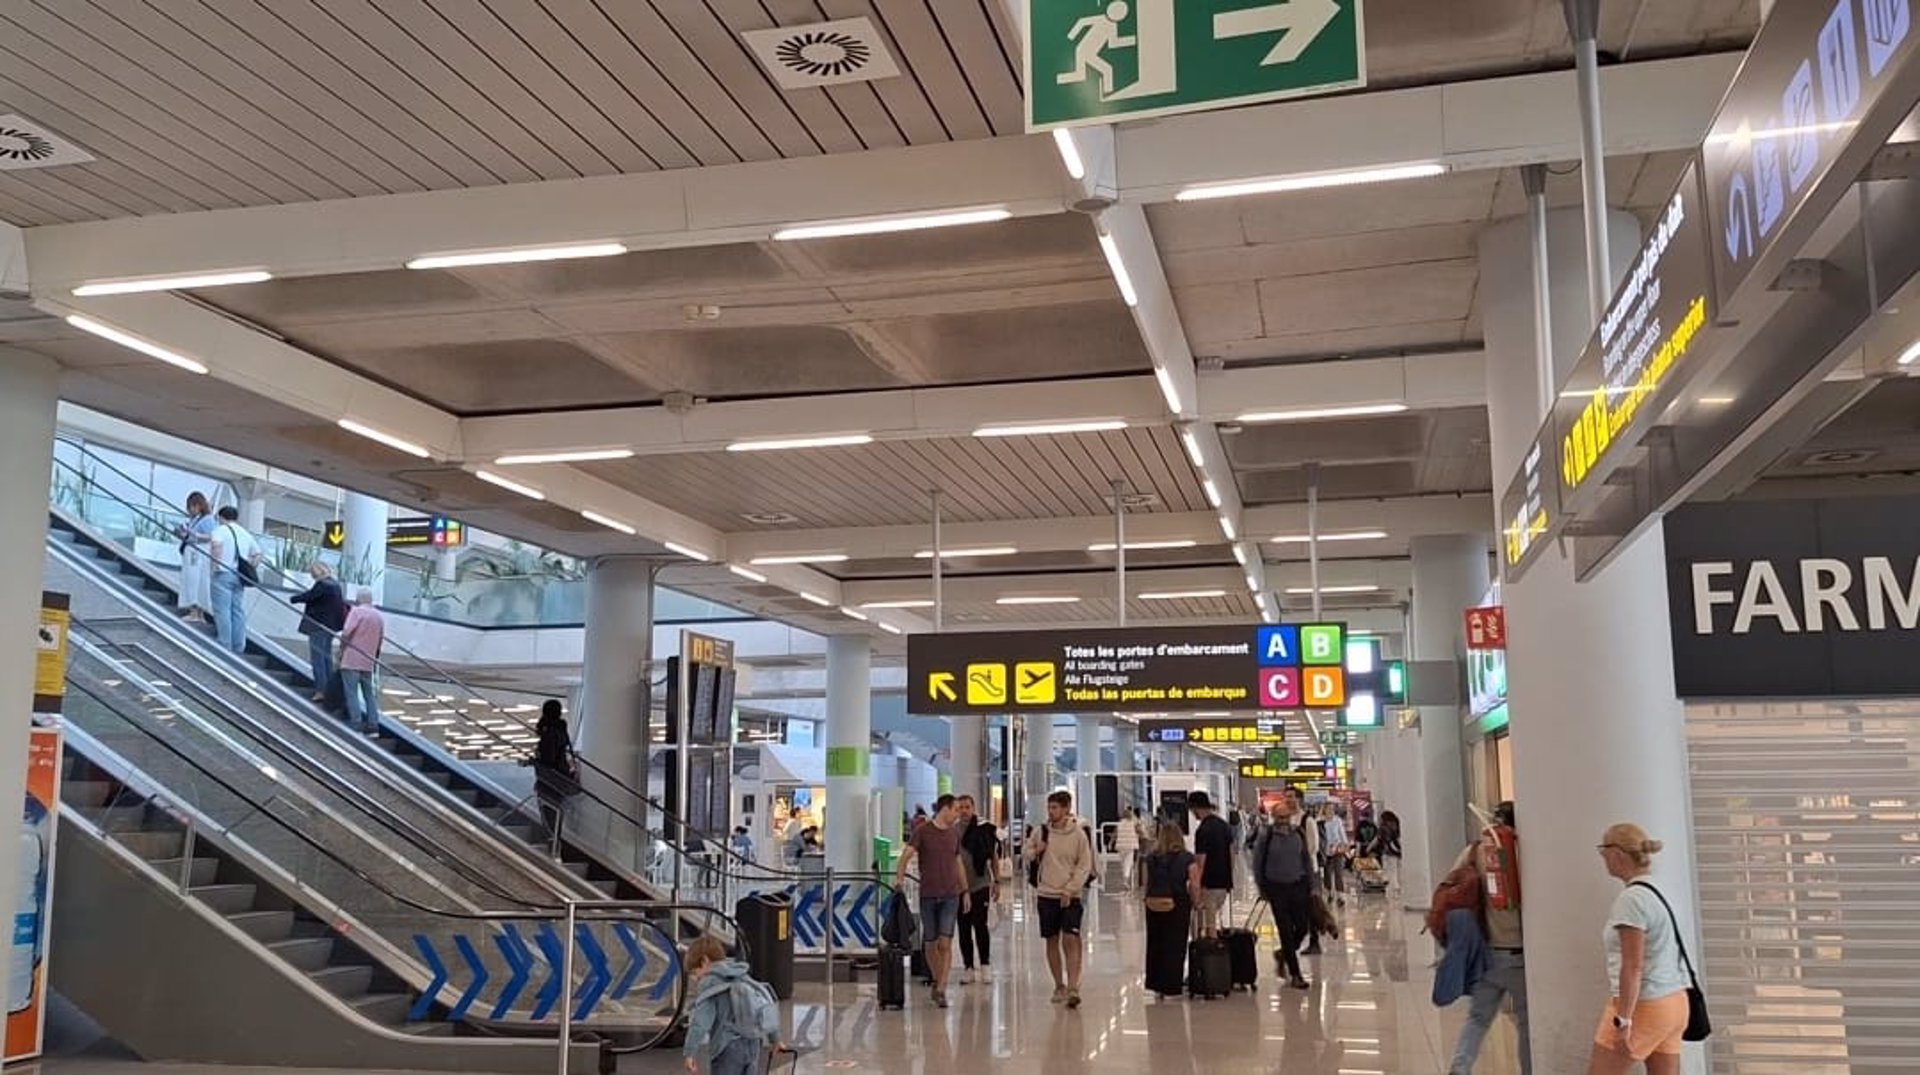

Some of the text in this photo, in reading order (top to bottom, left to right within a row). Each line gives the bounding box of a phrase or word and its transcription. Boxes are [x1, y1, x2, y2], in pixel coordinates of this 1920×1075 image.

[1692, 556, 1920, 634] FARM
[1064, 643, 1249, 660] Totes les portes d'embarcament
[1266, 632, 1330, 658] A B
[1064, 660, 1145, 672] All boarding gates
[1064, 674, 1129, 686] Alle Flugsteige
[1268, 674, 1333, 700] C D
[1065, 686, 1247, 702] Todas las puertas de embarque
